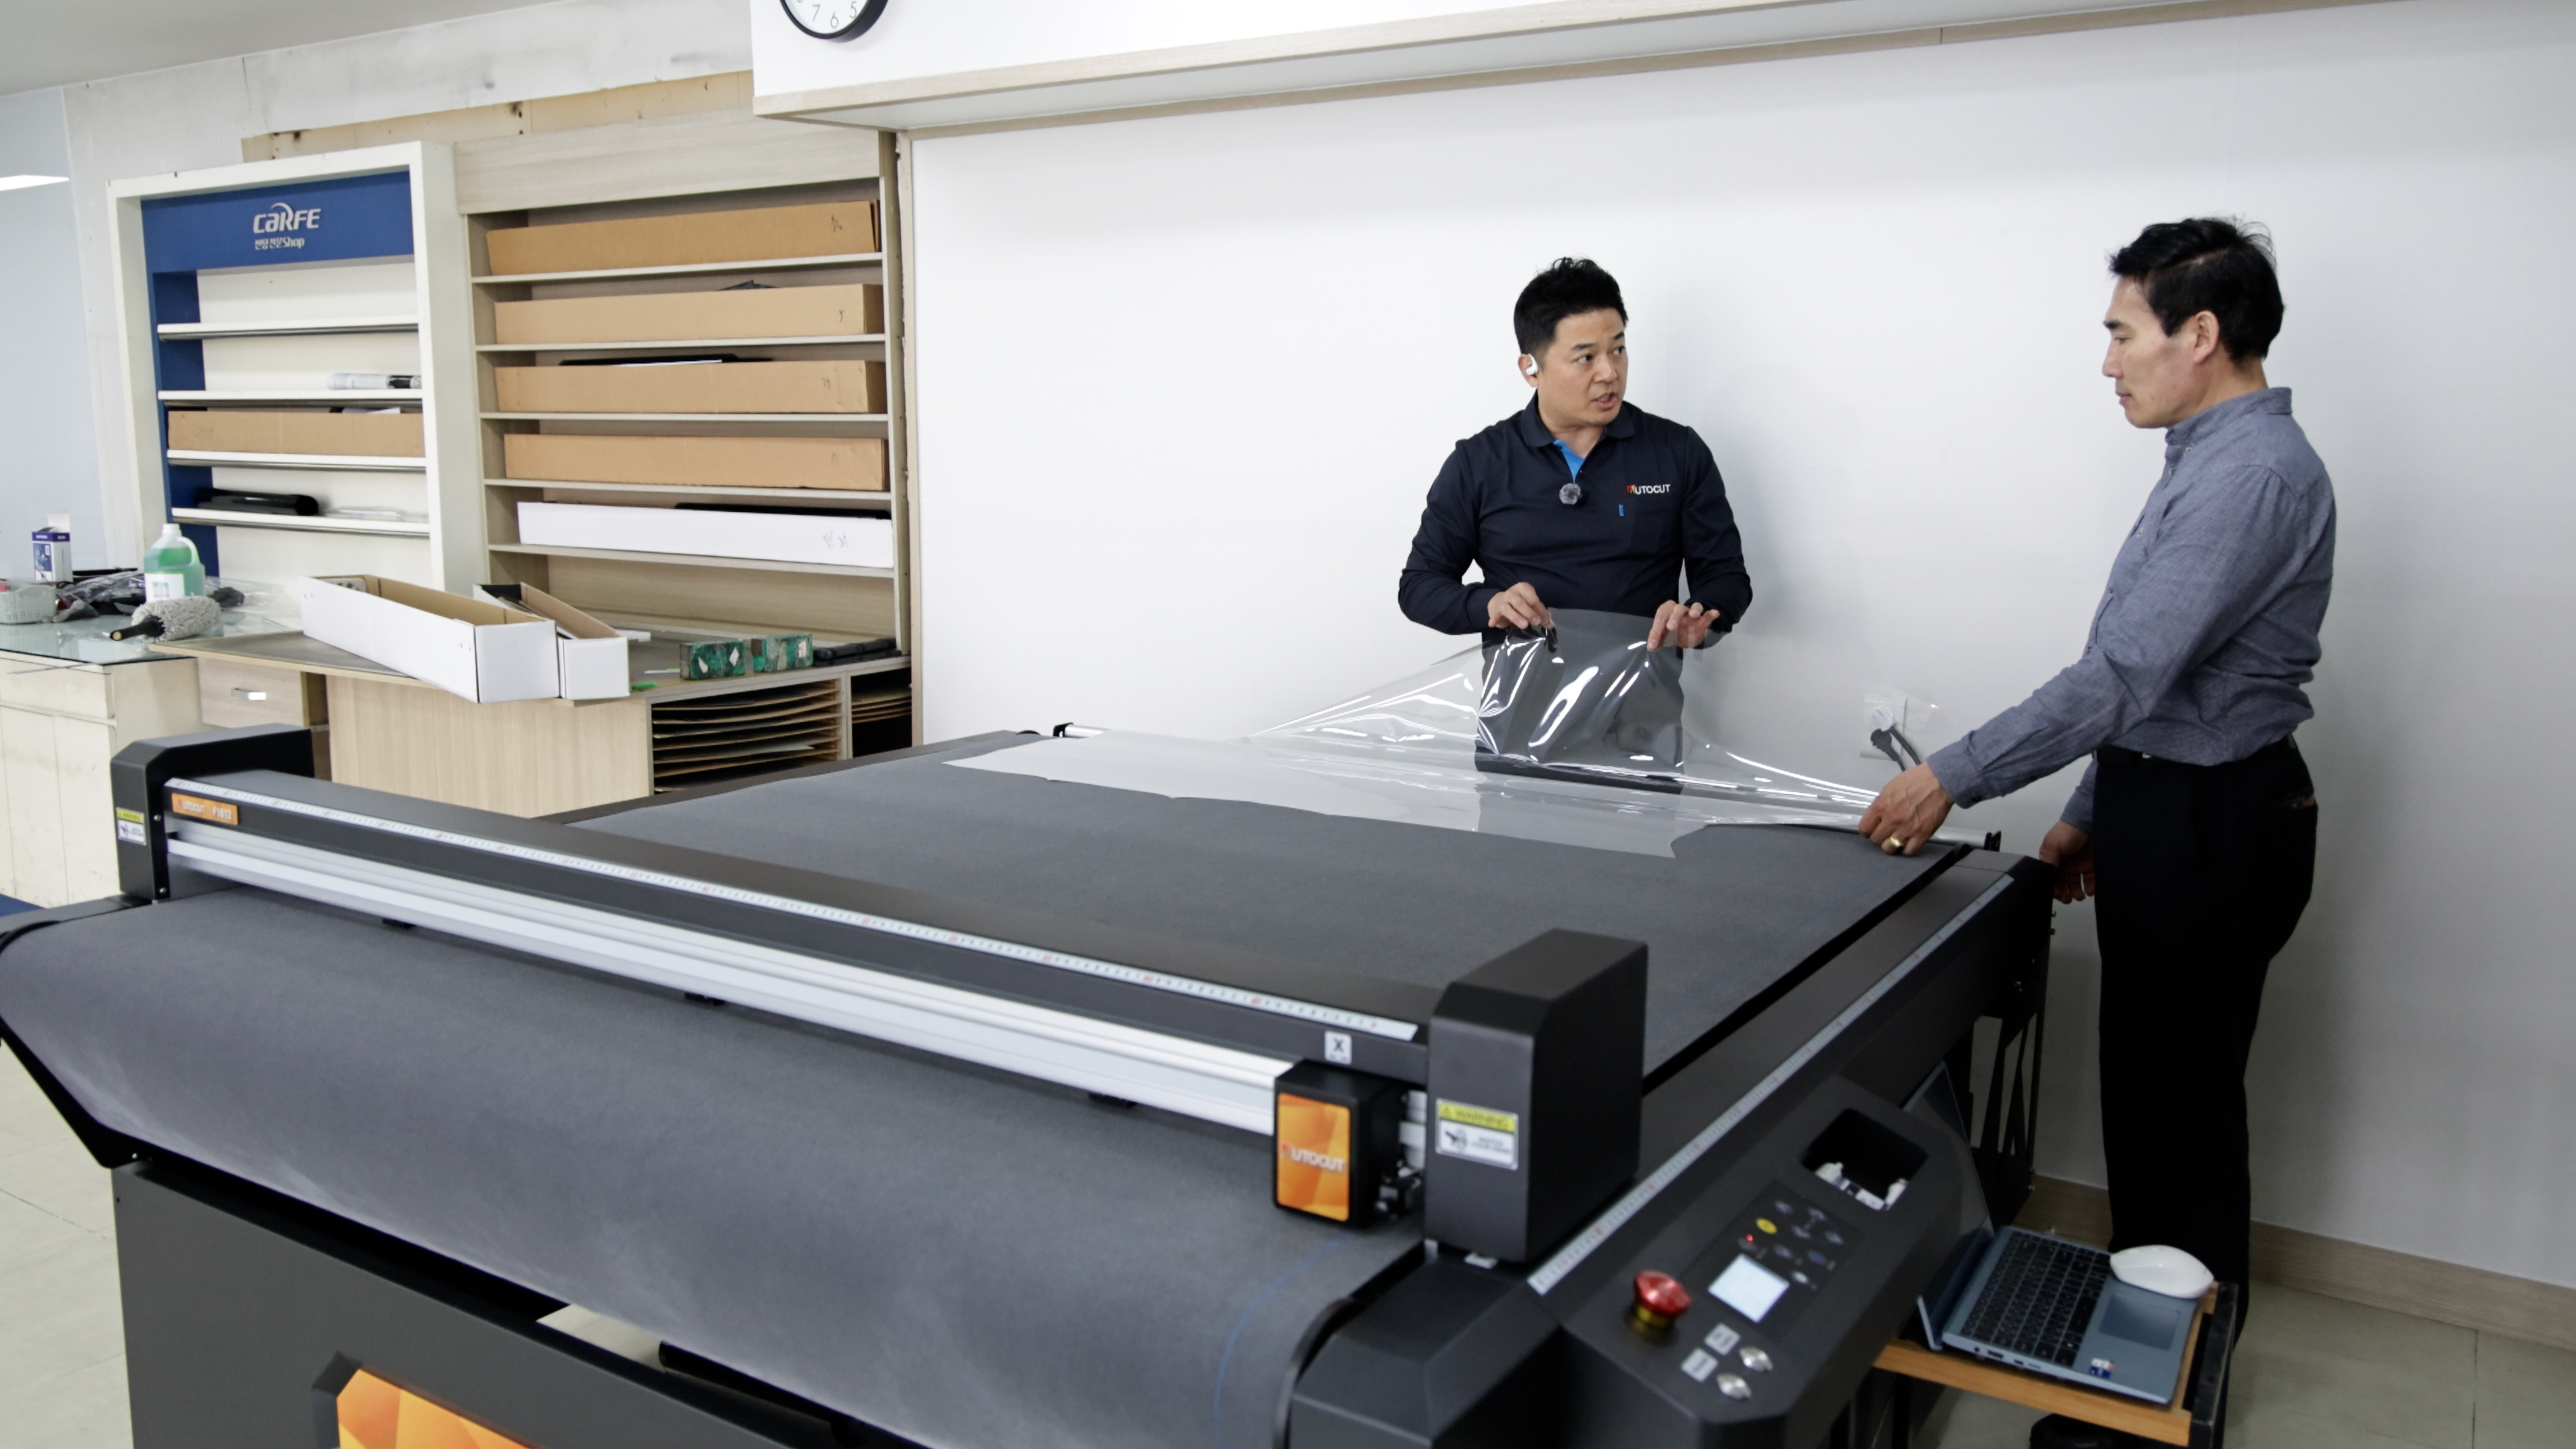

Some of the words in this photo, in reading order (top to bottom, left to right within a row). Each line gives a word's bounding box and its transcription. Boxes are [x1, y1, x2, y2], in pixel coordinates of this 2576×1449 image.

[812, 4, 820, 22] 7
[849, 1, 857, 19] 5
[830, 11, 839, 30] 6
[1333, 1037, 1344, 1053] X
